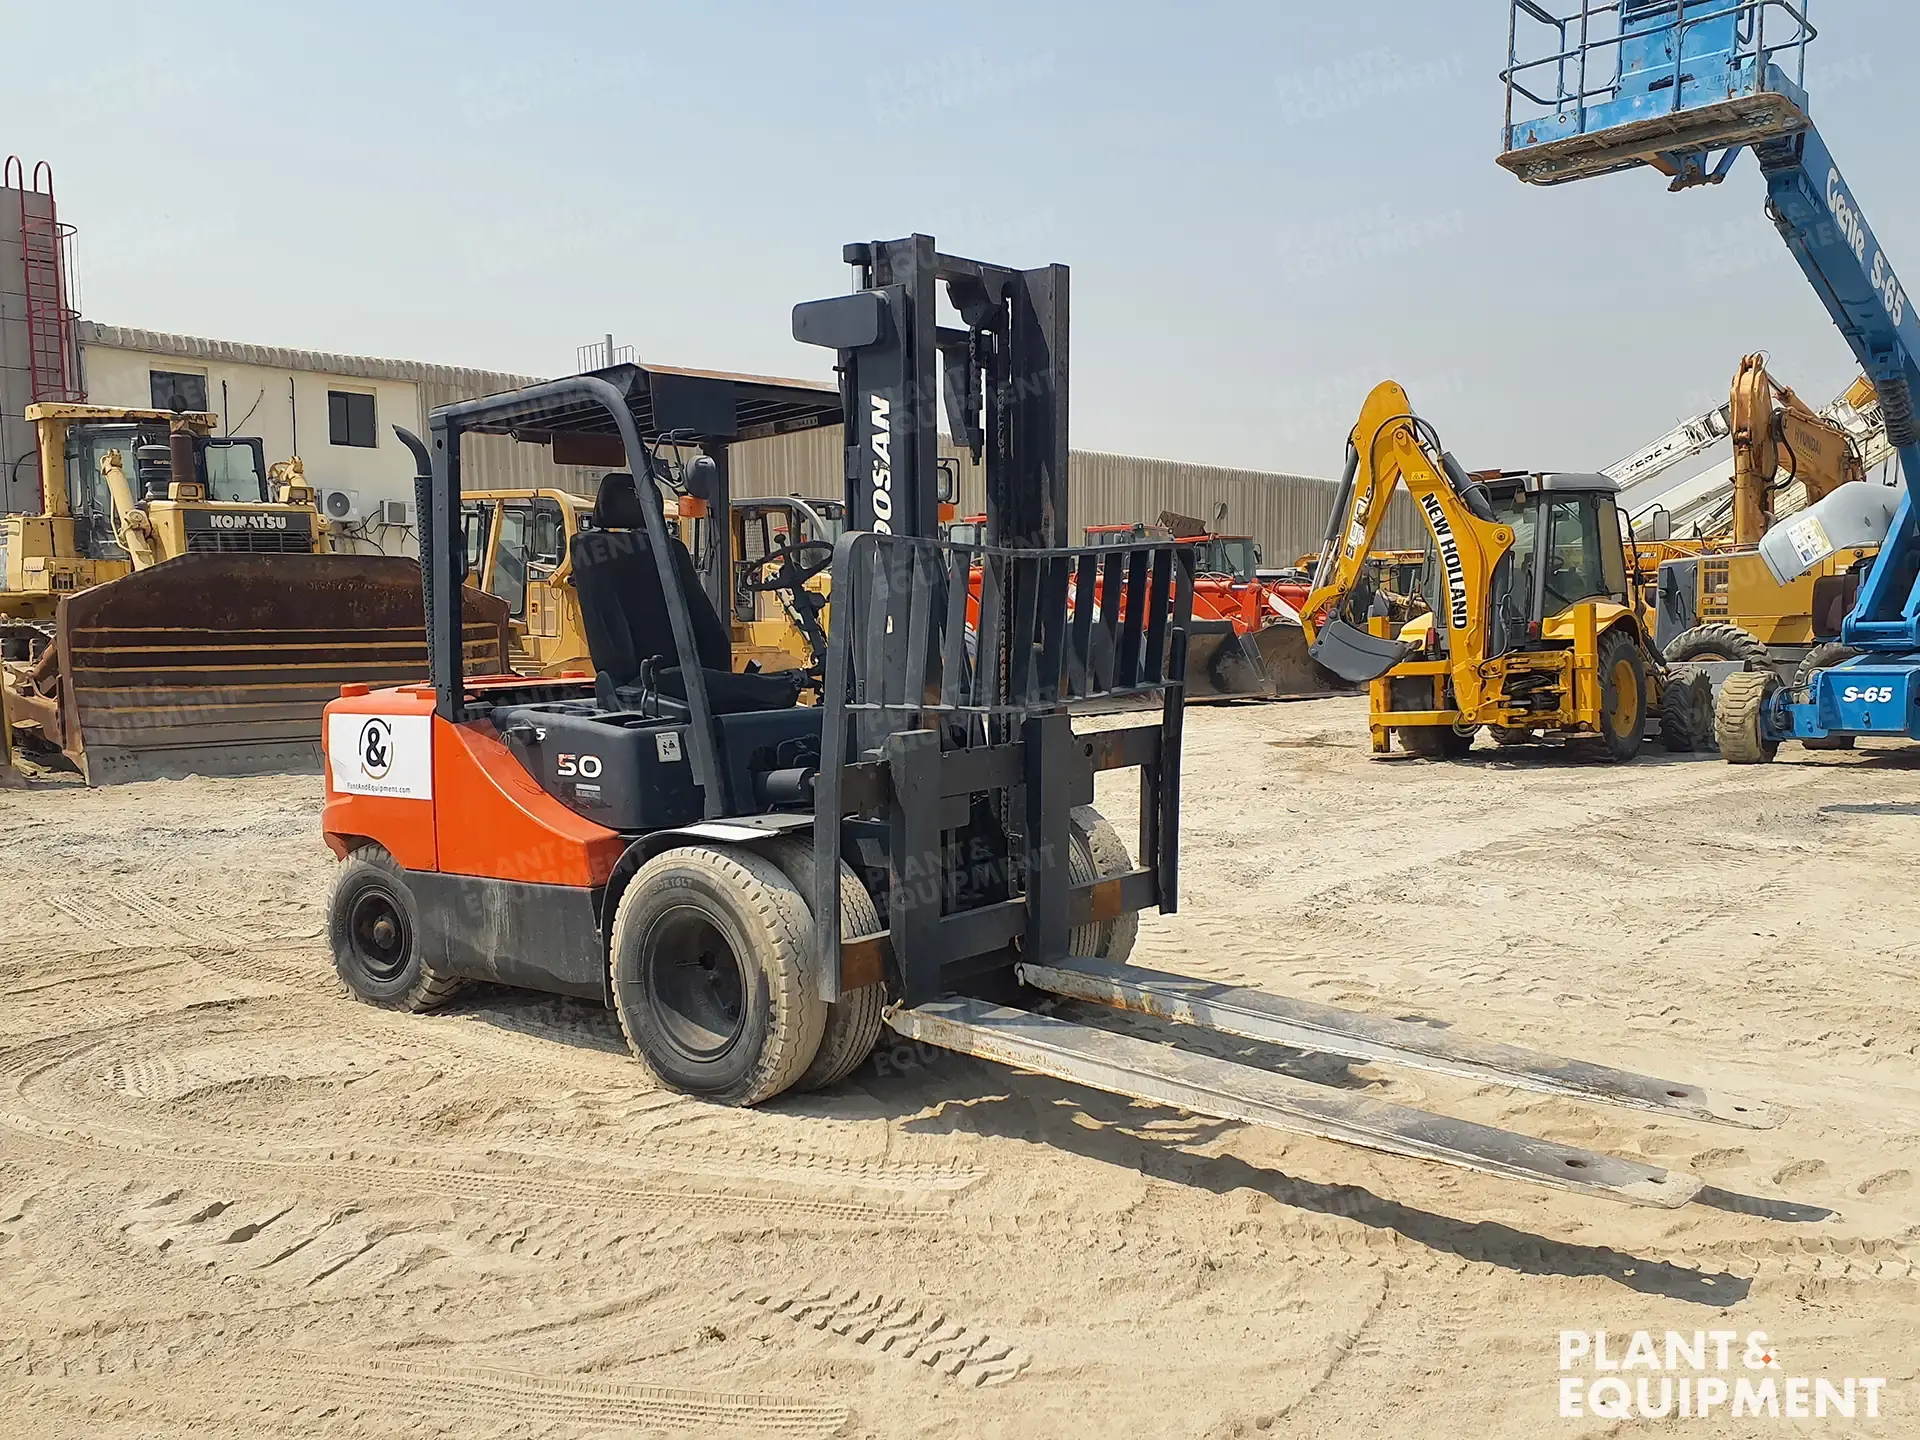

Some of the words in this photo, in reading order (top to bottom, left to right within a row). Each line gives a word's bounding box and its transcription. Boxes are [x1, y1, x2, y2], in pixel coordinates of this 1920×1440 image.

[1826, 167, 1865, 263] Genie
[210, 512, 287, 529] KOMATSU
[1420, 491, 1451, 537] NEW
[1440, 535, 1468, 630] HOLLAND
[1842, 686, 1893, 703] S-65
[557, 753, 603, 778] 50
